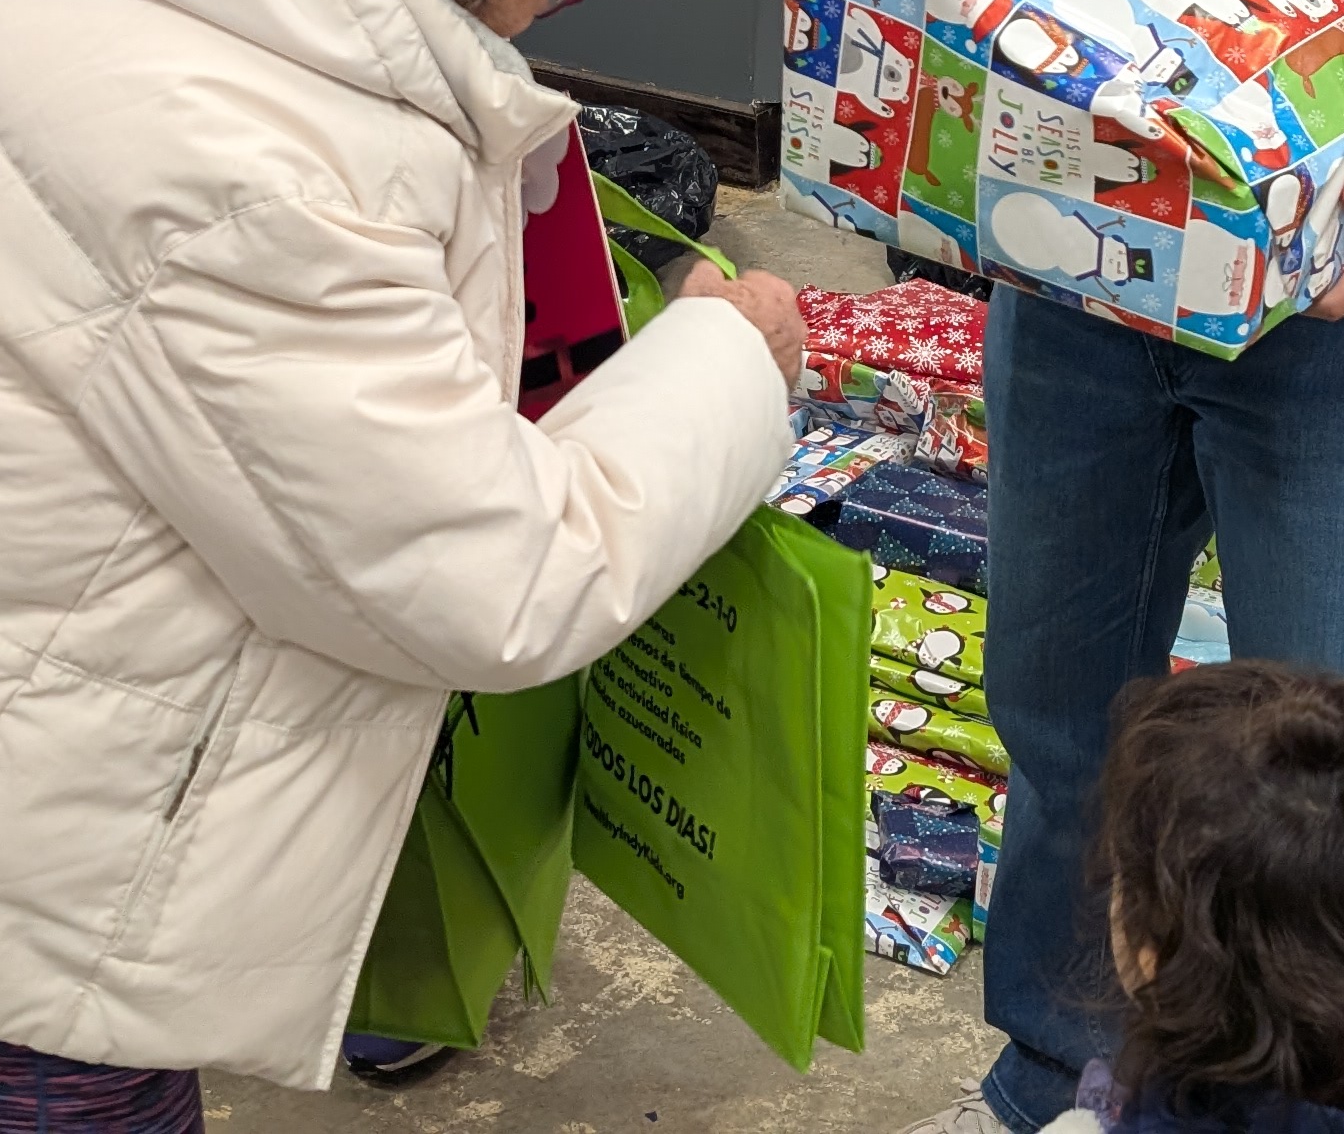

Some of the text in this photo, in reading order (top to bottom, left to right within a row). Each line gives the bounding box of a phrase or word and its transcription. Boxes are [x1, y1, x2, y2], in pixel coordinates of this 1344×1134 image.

[786, 87, 813, 167] SEASON
[988, 88, 1023, 178] JOLLY
[1021, 147, 1035, 165] BE
[1036, 110, 1065, 186] SEASON
[1066, 156, 1082, 178] THE
[617, 676, 670, 724] actividad
[716, 695, 731, 720] de
[618, 706, 686, 765] azucaradas
[628, 764, 665, 815] LOS
[665, 796, 717, 861] DIAS!
